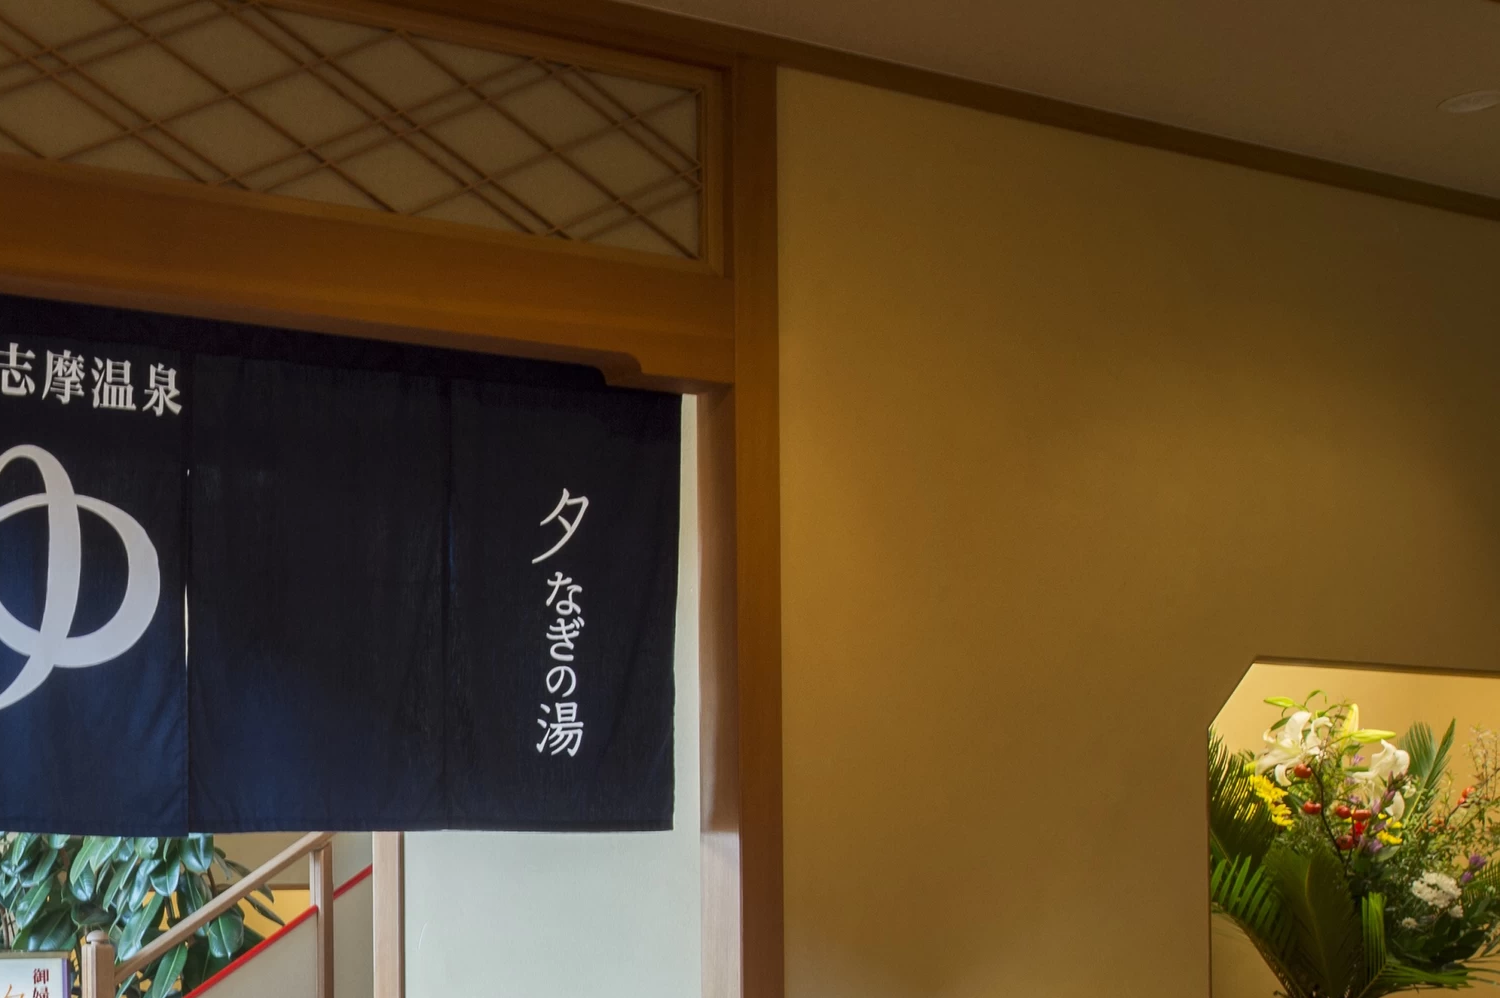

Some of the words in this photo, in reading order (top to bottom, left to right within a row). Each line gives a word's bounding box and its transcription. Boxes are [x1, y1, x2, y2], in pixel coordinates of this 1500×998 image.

[531, 487, 590, 757] 夕なぎの湯
